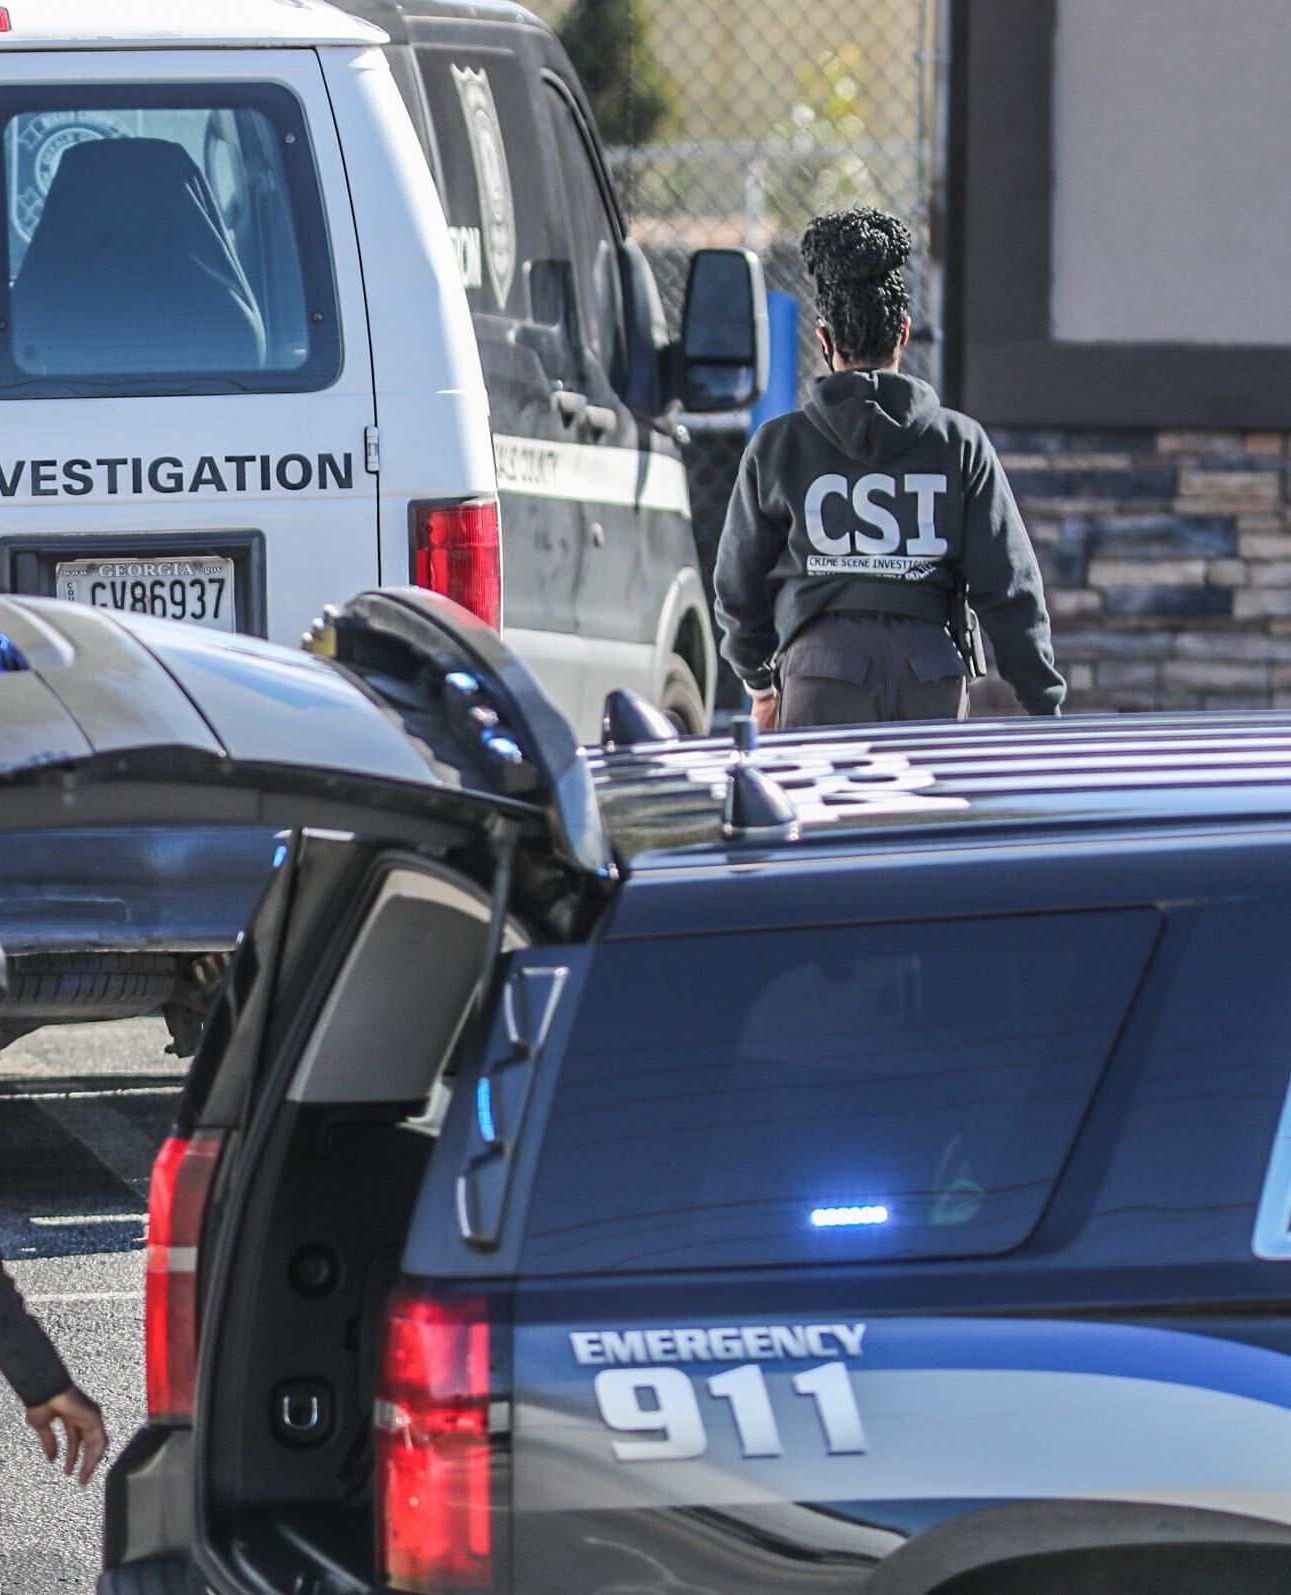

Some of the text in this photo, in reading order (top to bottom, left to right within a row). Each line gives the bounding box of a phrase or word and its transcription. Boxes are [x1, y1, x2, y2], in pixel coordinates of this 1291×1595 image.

[804, 473, 948, 556] CSI
[98, 562, 196, 578] GEORGIA
[809, 557, 930, 570] CRIME SCENE INVESTI
[569, 1323, 866, 1364] EMERGENCY
[594, 1361, 867, 1462] 911
